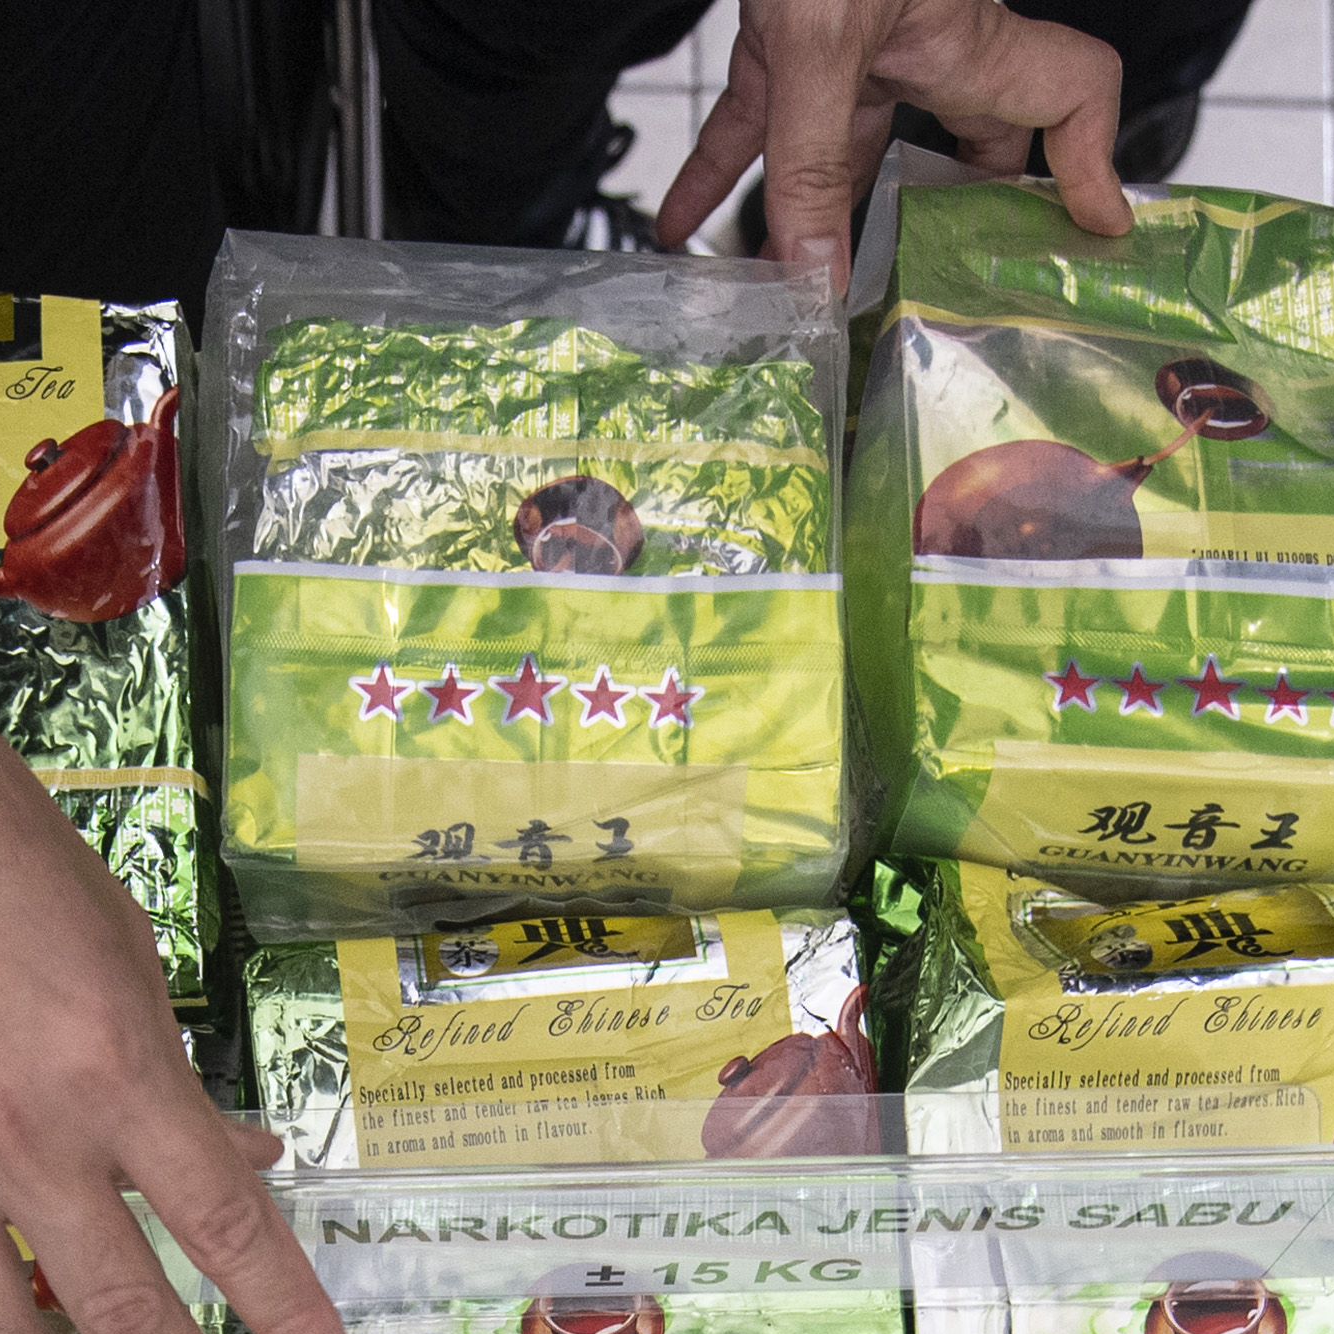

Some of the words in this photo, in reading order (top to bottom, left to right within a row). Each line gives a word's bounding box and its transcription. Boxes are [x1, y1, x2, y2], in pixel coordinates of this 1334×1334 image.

[6, 366, 75, 400] Tea
[1077, 801, 1299, 850] 观音王
[1039, 845, 1308, 872] GUANYINWANG
[373, 1003, 531, 1061] Refined
[696, 984, 764, 1022] Tea
[1029, 998, 1189, 1051] Refined
[359, 1080, 425, 1108] Specially
[433, 1072, 494, 1096] selected
[501, 1069, 523, 1089] and
[529, 1063, 597, 1091] processed
[604, 1060, 635, 1080] from
[1004, 1069, 1071, 1091] Specially
[1079, 1068, 1139, 1088] selected
[1146, 1067, 1169, 1086] and
[1174, 1065, 1242, 1088] processed
[1250, 1066, 1280, 1085] from
[1035, 1097, 1076, 1116] finest
[1116, 1093, 1158, 1113] tender
[387, 1137, 426, 1154] aroma
[461, 1125, 506, 1147] smooth
[1027, 1128, 1064, 1143] aroma
[1100, 1121, 1143, 1140] smooth
[322, 1210, 790, 1244] NARKOTIKA
[818, 1203, 1047, 1235] JENIS
[1068, 1200, 1295, 1229] SABU
[652, 1260, 730, 1286] 15
[754, 1257, 863, 1284] KG
